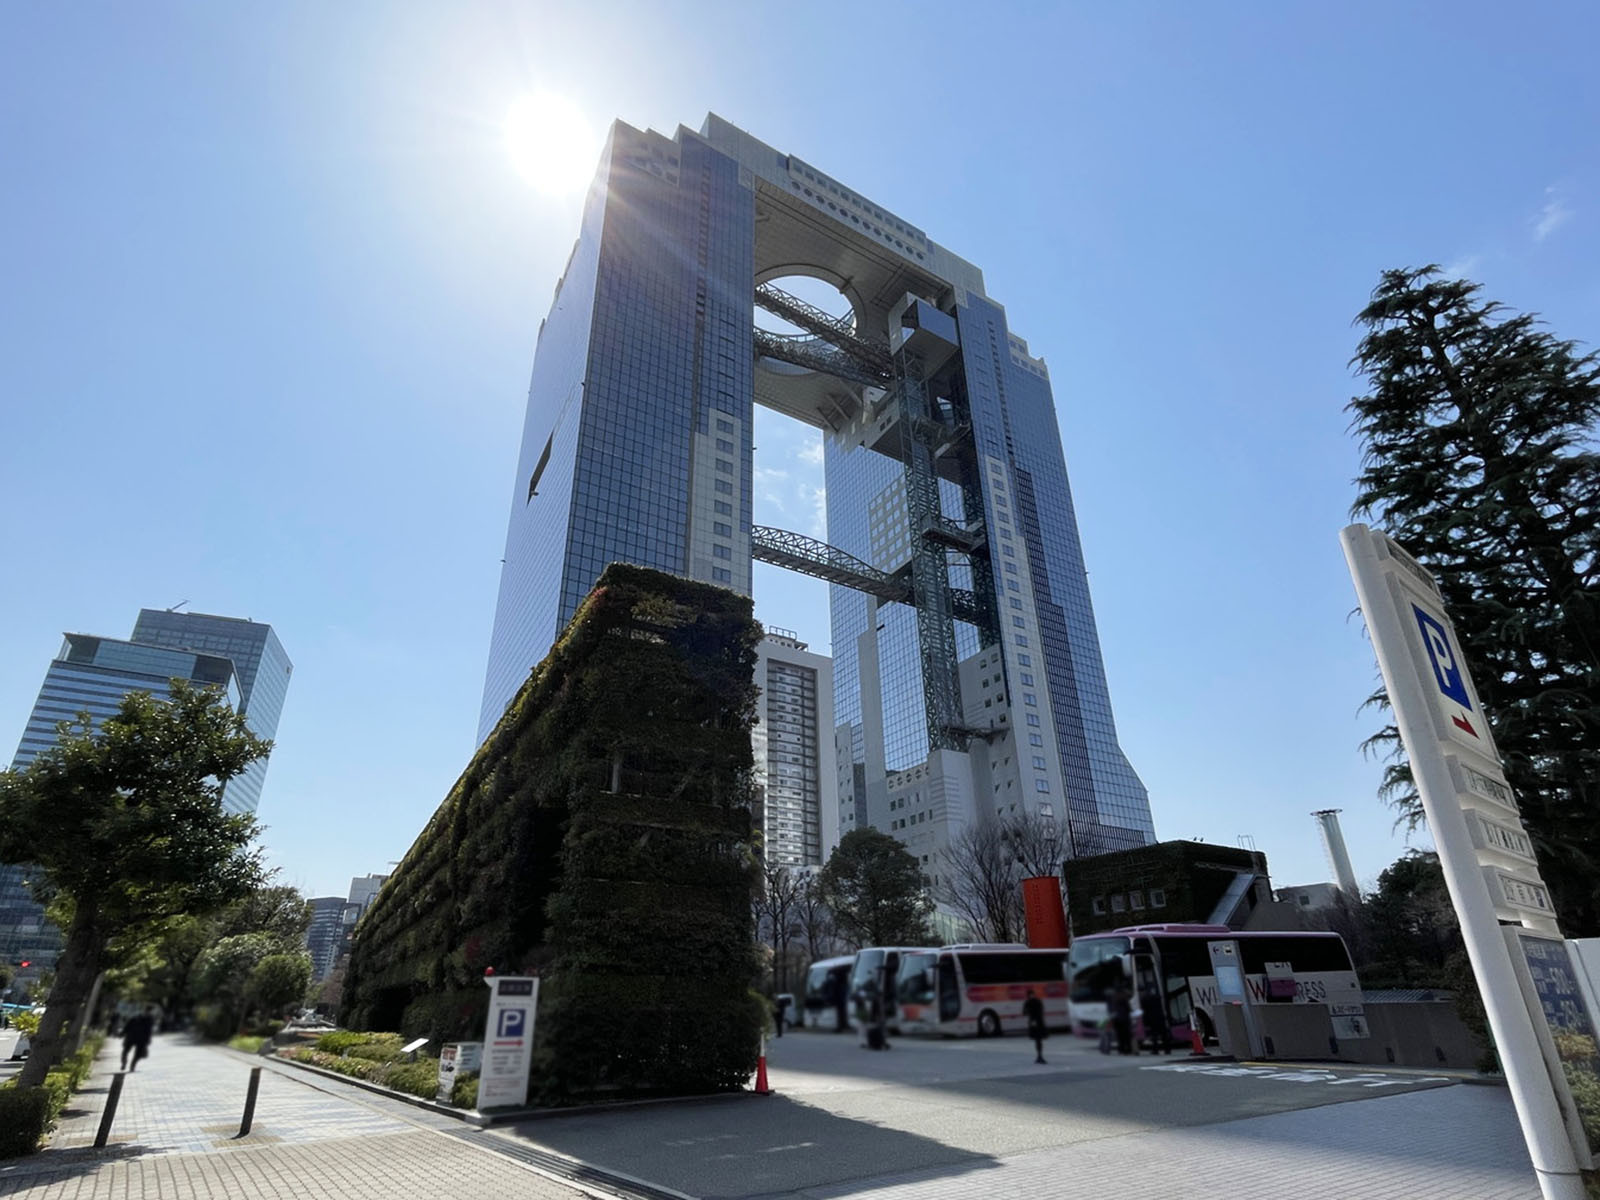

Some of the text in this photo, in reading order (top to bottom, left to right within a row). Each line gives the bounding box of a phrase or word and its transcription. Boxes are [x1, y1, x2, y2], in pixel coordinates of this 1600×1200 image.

[1423, 621, 1453, 688] P
[1196, 986, 1218, 1005] WI
[501, 1011, 521, 1037] P
